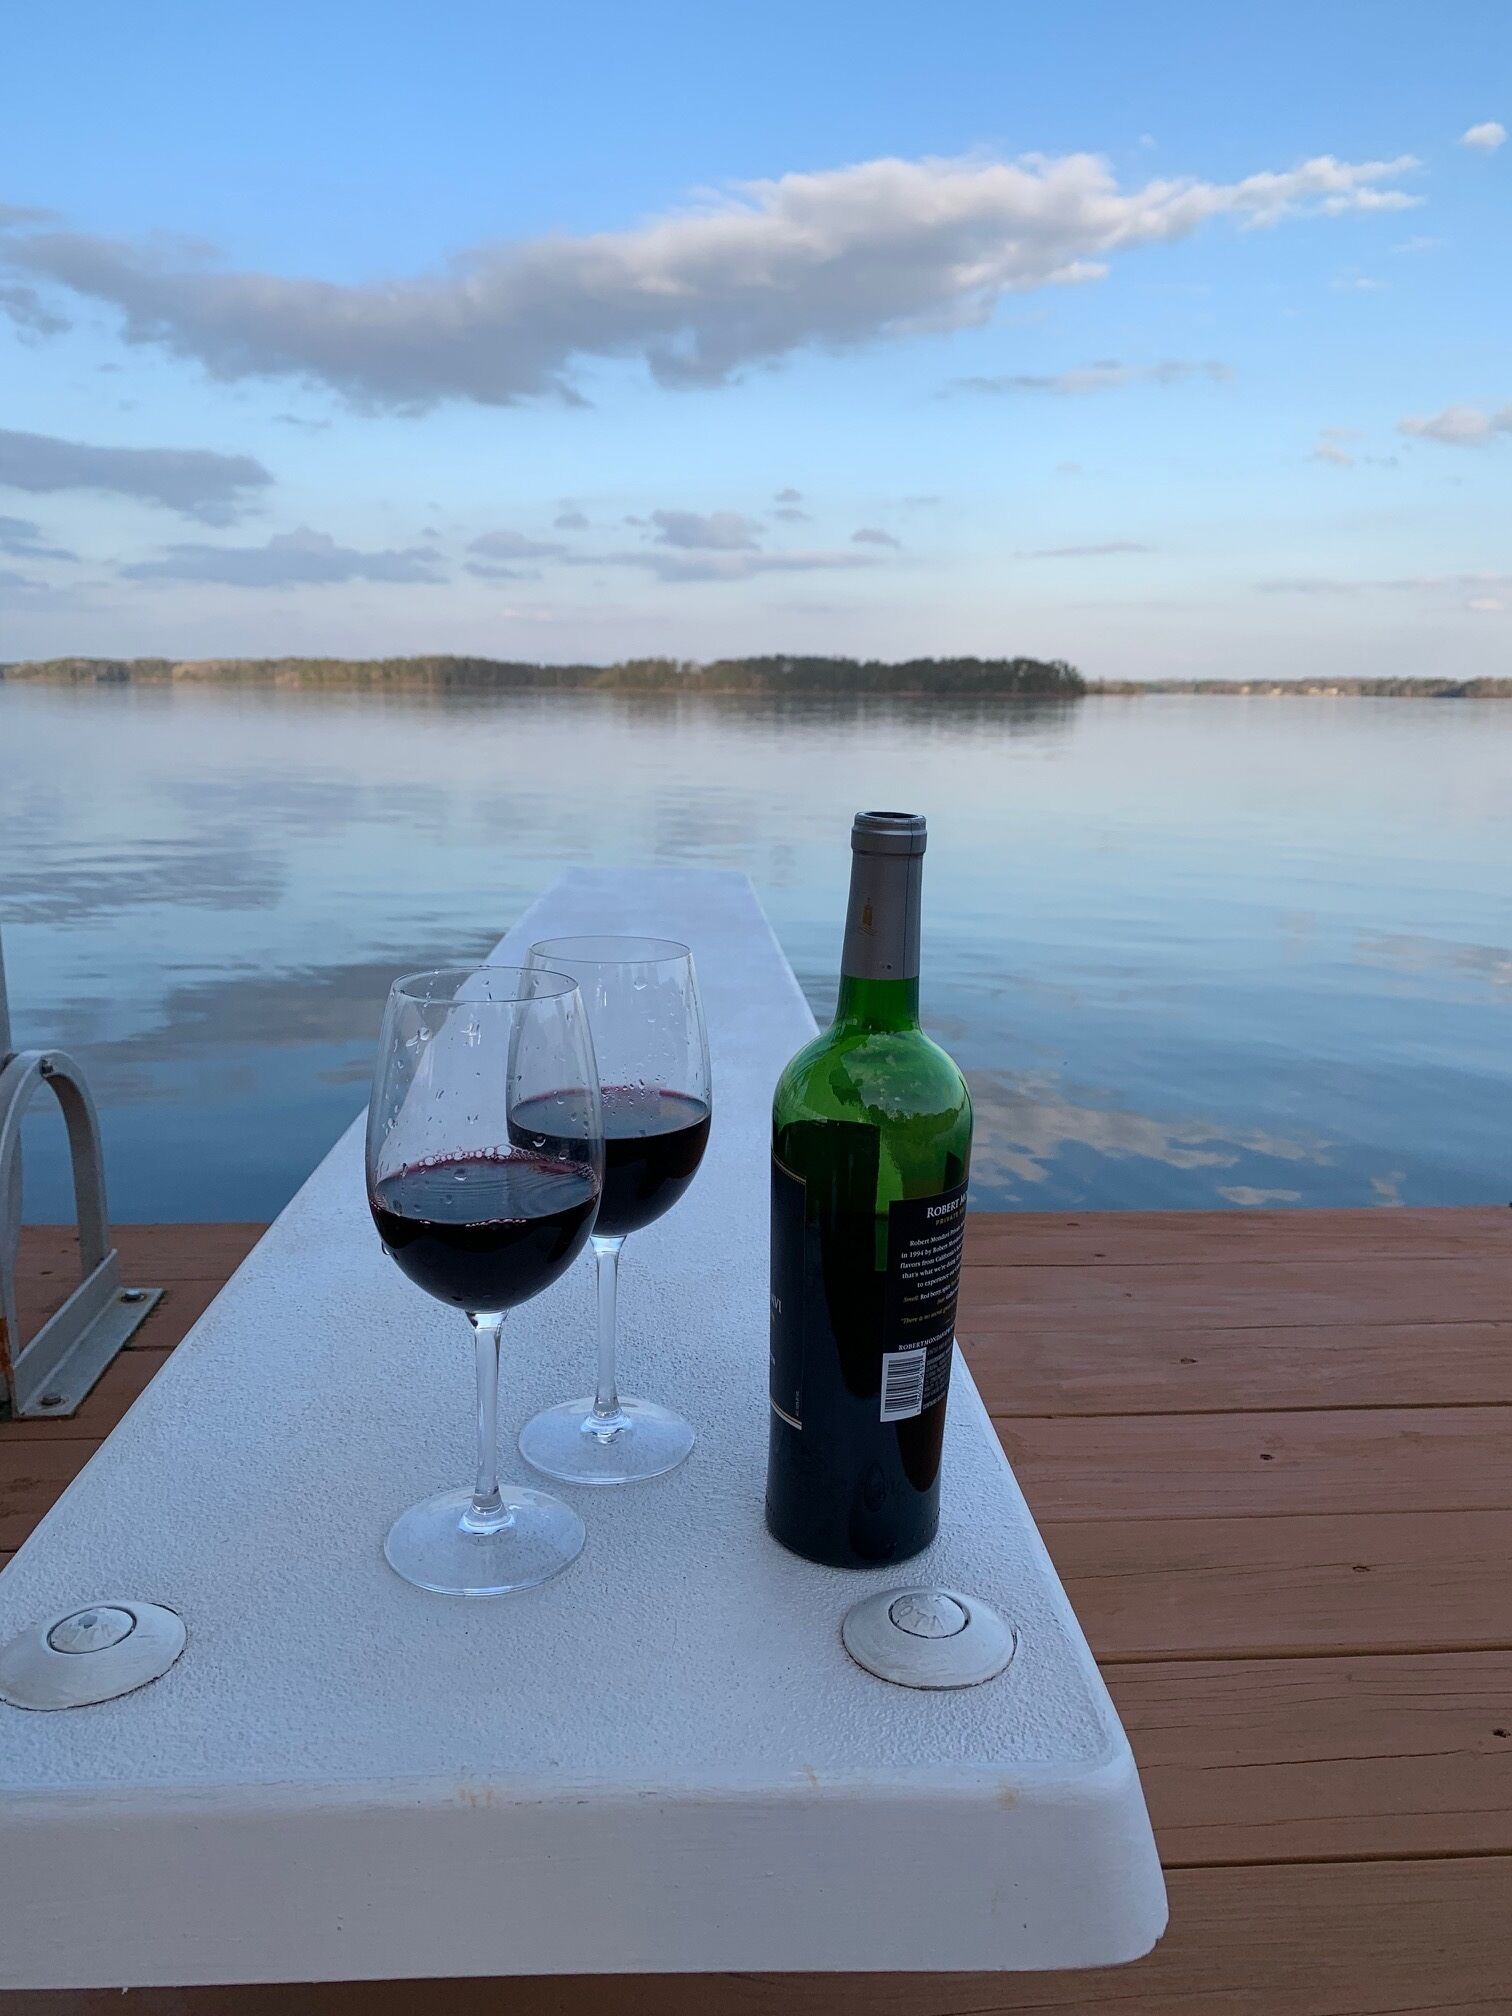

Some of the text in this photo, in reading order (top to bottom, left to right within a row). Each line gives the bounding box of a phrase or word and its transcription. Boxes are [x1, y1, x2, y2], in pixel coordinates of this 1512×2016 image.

[927, 1198, 959, 1218] ROBERT
[910, 1239, 930, 1247] Robert
[910, 1249, 924, 1258] 1994
[900, 1261, 921, 1269] flavors
[902, 1271, 919, 1279] that's
[919, 1268, 933, 1276] what
